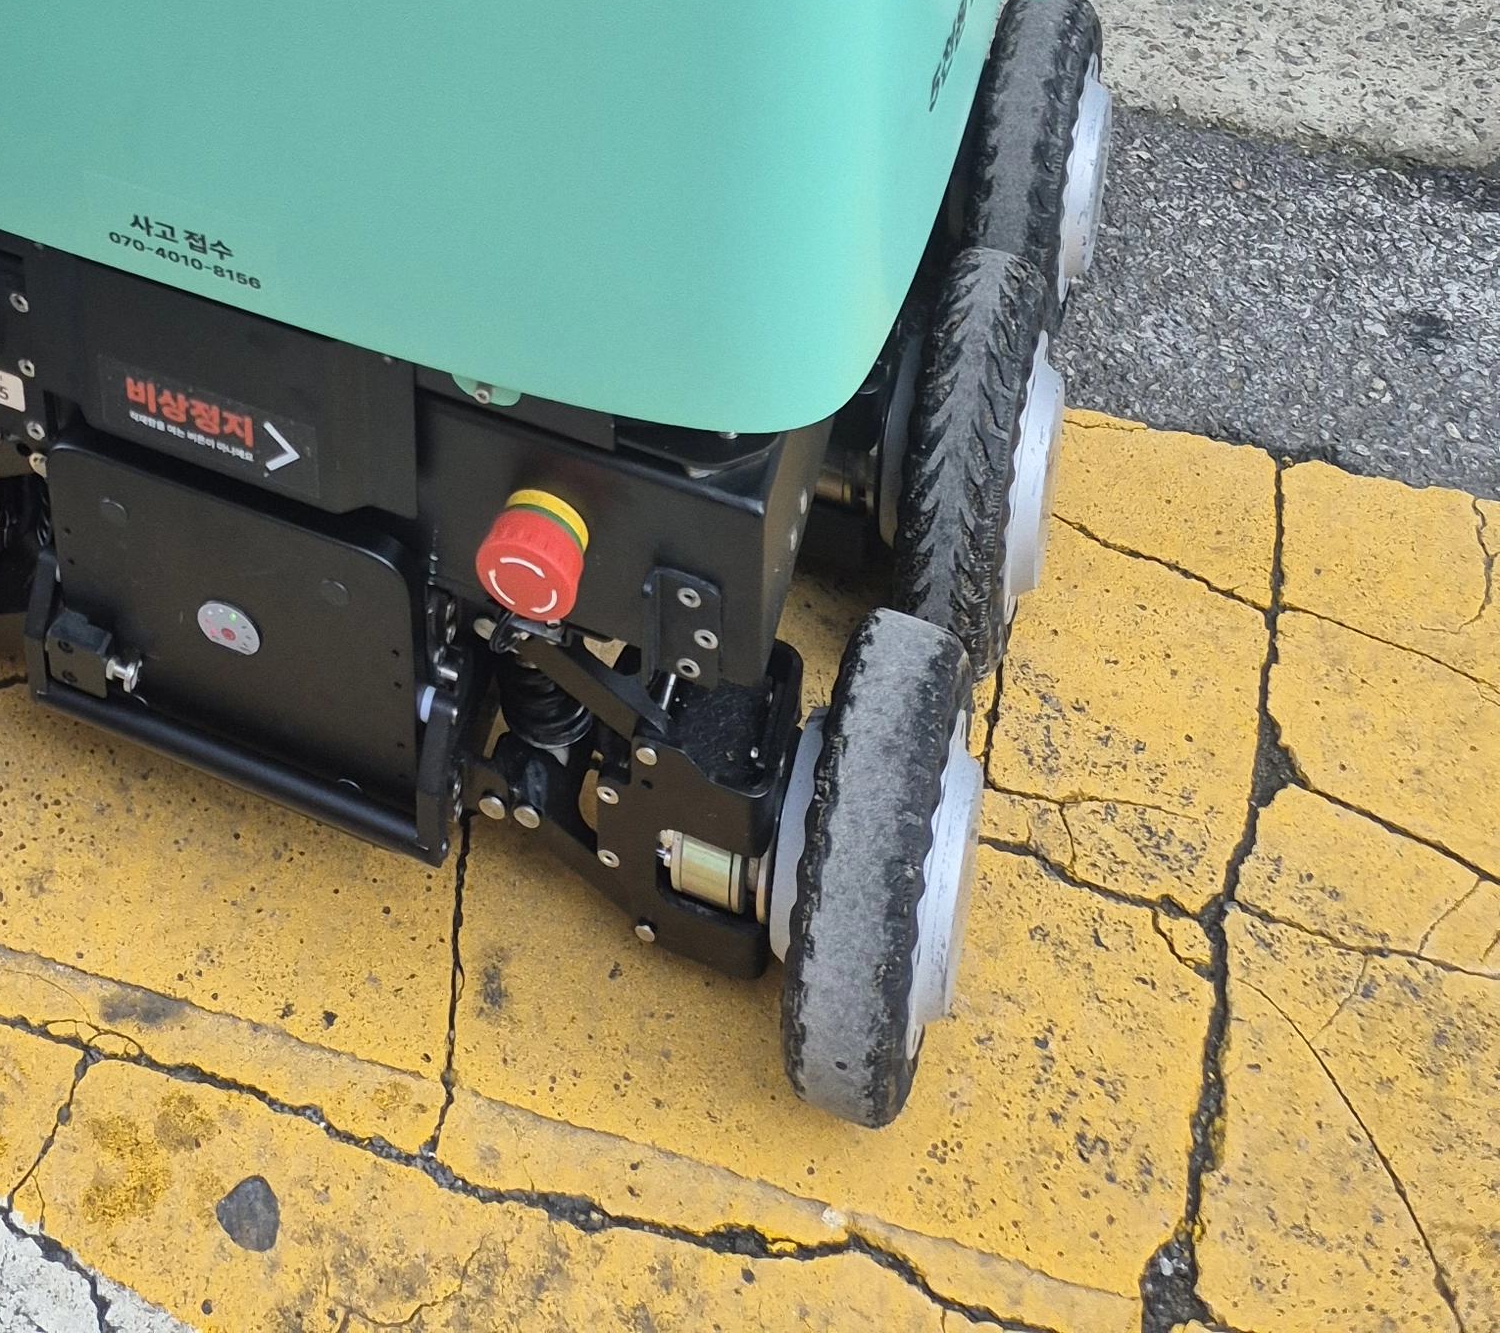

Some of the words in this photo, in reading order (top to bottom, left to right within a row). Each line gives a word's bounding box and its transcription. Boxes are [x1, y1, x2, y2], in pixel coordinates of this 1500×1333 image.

[108, 231, 262, 290] 070-4010-8156
[129, 213, 179, 244] 사고
[183, 229, 234, 260] 접수
[125, 376, 255, 448] 비상정지
